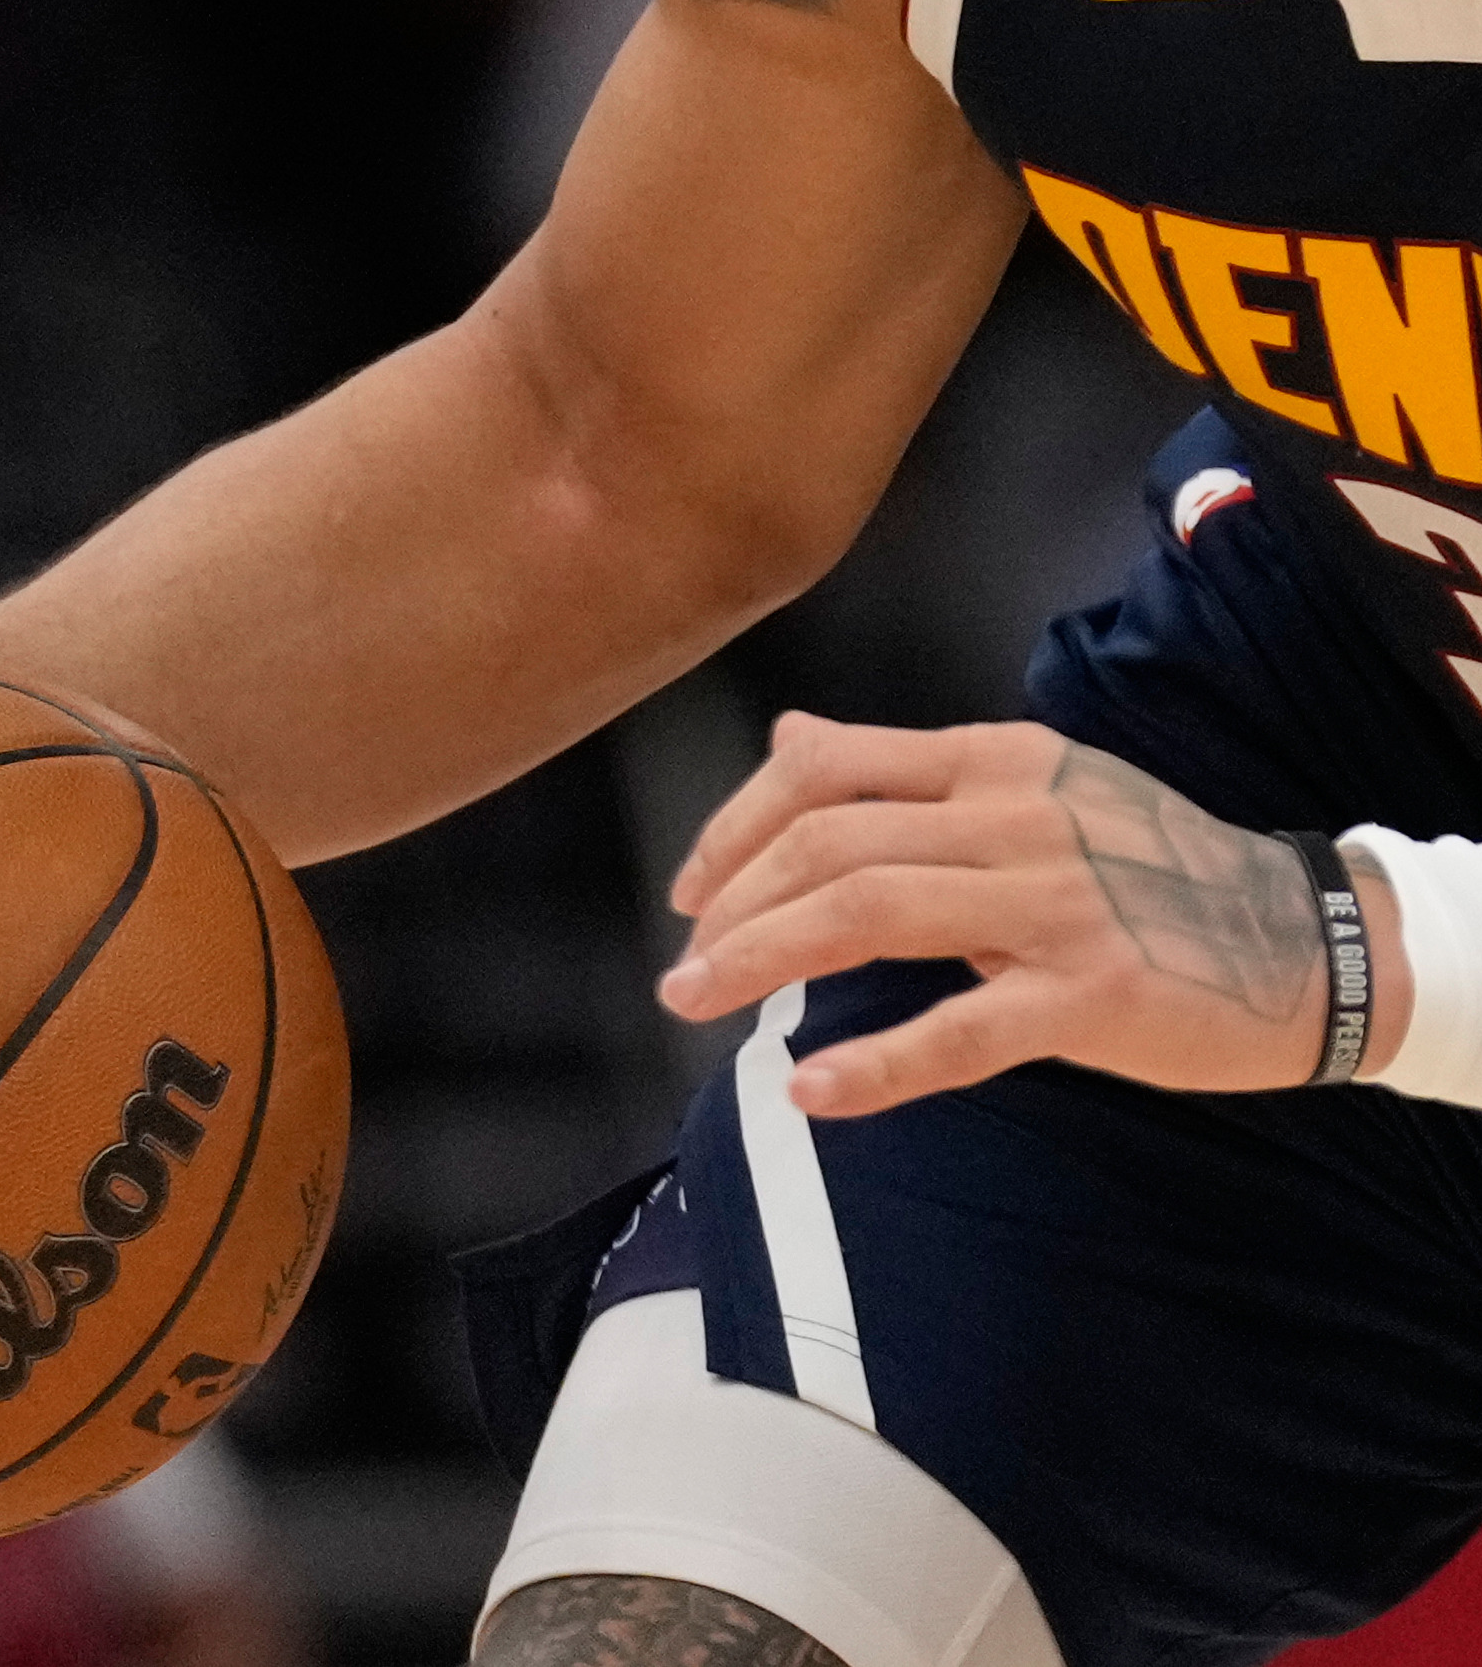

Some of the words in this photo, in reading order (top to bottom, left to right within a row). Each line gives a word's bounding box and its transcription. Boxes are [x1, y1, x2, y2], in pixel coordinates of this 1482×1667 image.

[1323, 891, 1358, 918] BE
[1332, 922, 1362, 939] A
[1337, 944, 1368, 1005] GOOD
